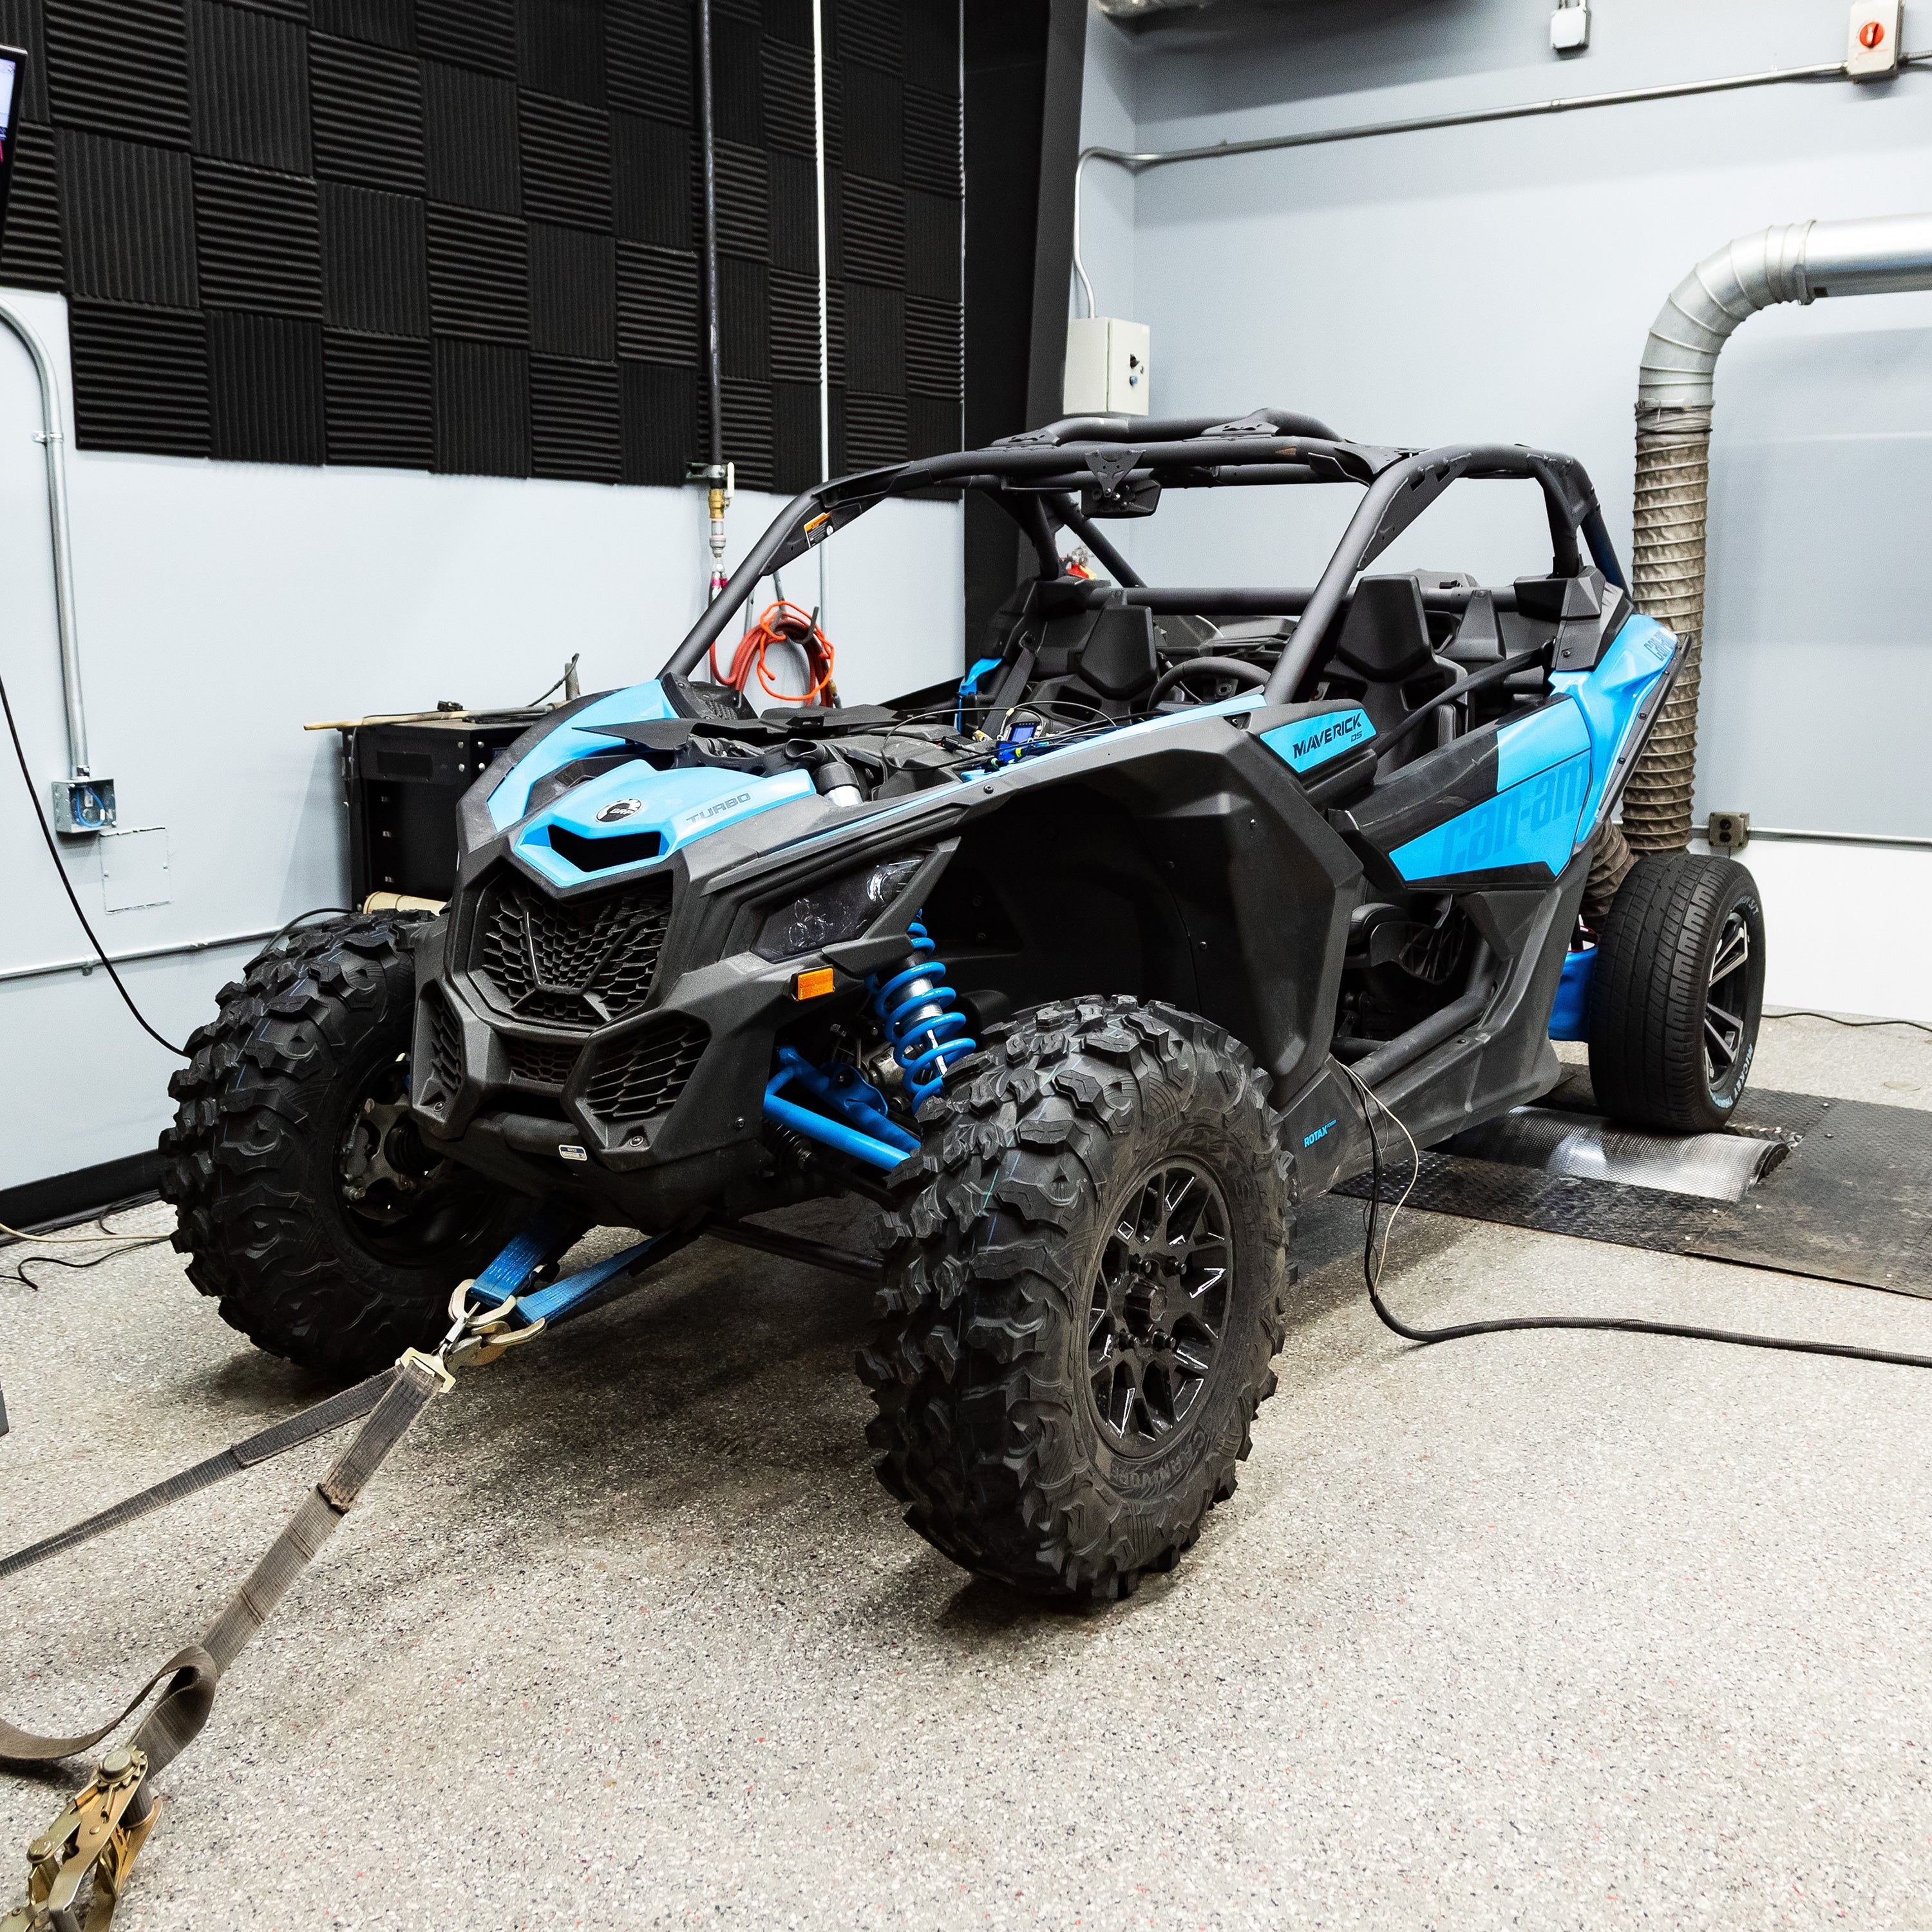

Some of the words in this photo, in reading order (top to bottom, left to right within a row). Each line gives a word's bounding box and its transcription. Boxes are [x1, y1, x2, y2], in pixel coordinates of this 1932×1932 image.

[1293, 713, 1361, 759] MAVERICK
[1350, 731, 1363, 743] DS
[609, 807, 636, 815] BRP
[686, 793, 751, 822] TURBO
[1734, 1043, 1753, 1099] MICKEY
[1303, 1124, 1329, 1148] ROTAX
